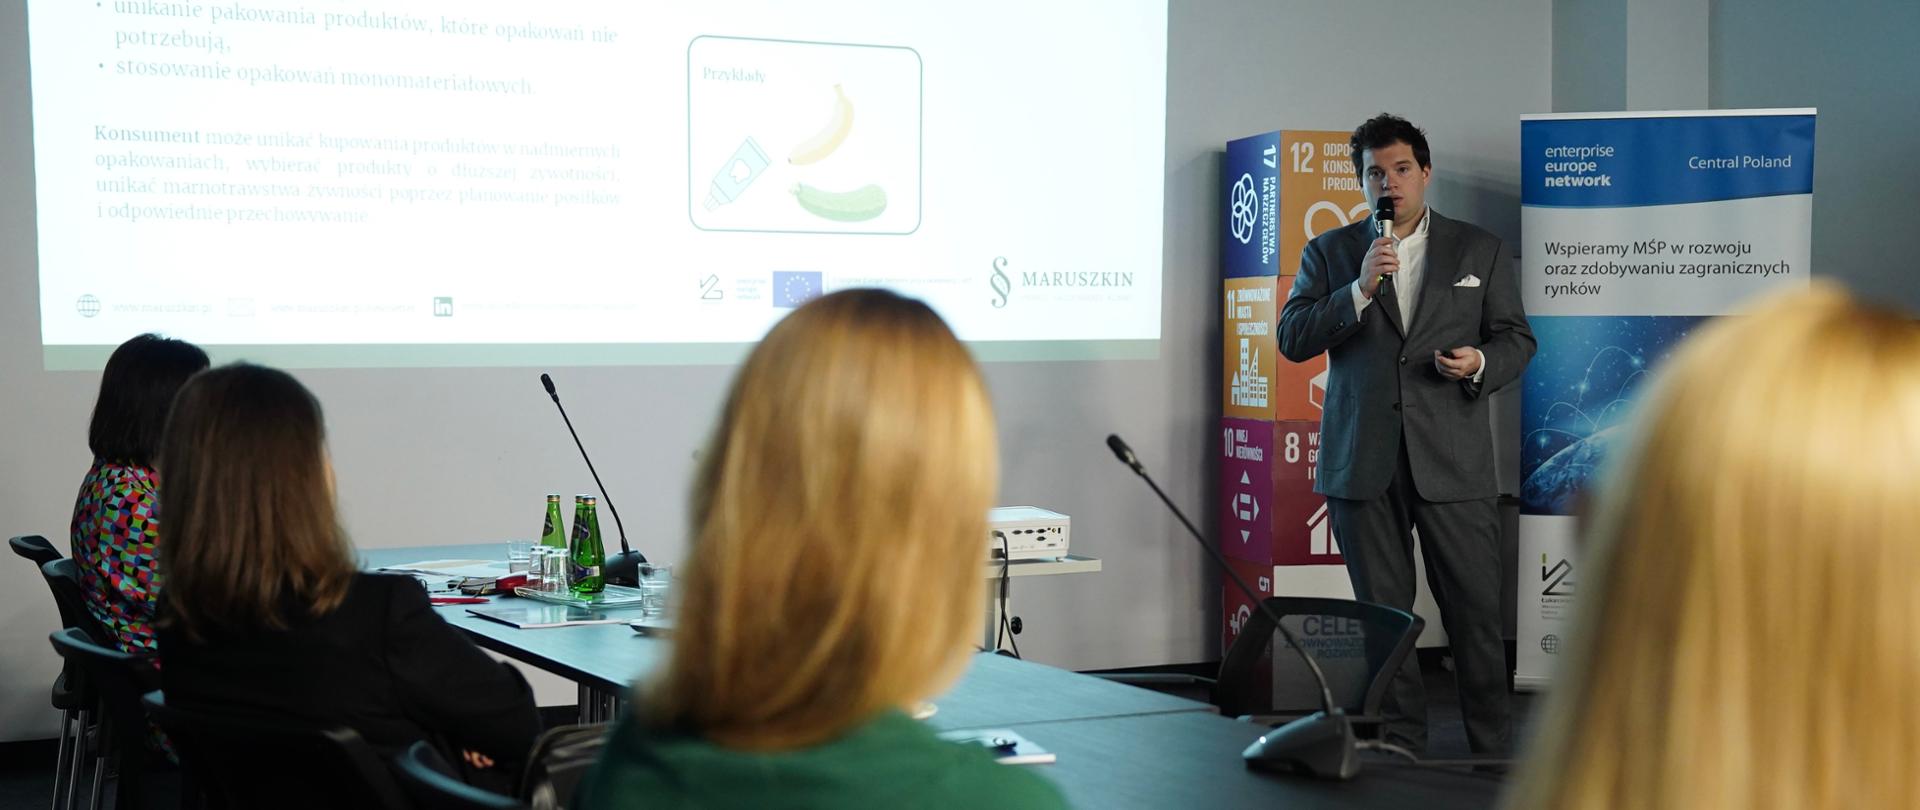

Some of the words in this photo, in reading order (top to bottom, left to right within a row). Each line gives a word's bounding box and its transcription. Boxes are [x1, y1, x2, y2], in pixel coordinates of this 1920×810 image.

[210, 3, 316, 25] pakowania
[440, 14, 489, 36] które
[591, 24, 619, 44] nie
[114, 28, 231, 54] potrzebują,
[115, 60, 231, 80] stosowanie
[237, 64, 336, 87] opakowań
[94, 124, 201, 144] Konsument
[1263, 144, 1277, 169] 17
[1290, 142, 1314, 173] 12
[1323, 143, 1354, 157] ODPO
[1545, 144, 1614, 160] enterprise
[94, 150, 230, 172] opakowaniach,
[1323, 160, 1357, 174] KONSU
[1545, 161, 1597, 176] europe
[1688, 156, 1739, 169] Central
[1743, 155, 1791, 168] Poland
[163, 178, 301, 197] marnotrawstwa
[1545, 174, 1612, 187] network
[1545, 241, 1629, 259] Wspieramy
[1633, 239, 1667, 255] MŚP
[1671, 244, 1684, 254] w
[1688, 241, 1751, 257] rozwoju
[1544, 265, 1577, 275] oraz
[1581, 261, 1675, 278] zdobywaniu
[1679, 260, 1790, 278] zagranicznych
[1021, 271, 1134, 287] MARUSZKIN
[1544, 281, 1601, 299] rynków
[1224, 427, 1234, 457] 10
[1285, 432, 1300, 464] 8
